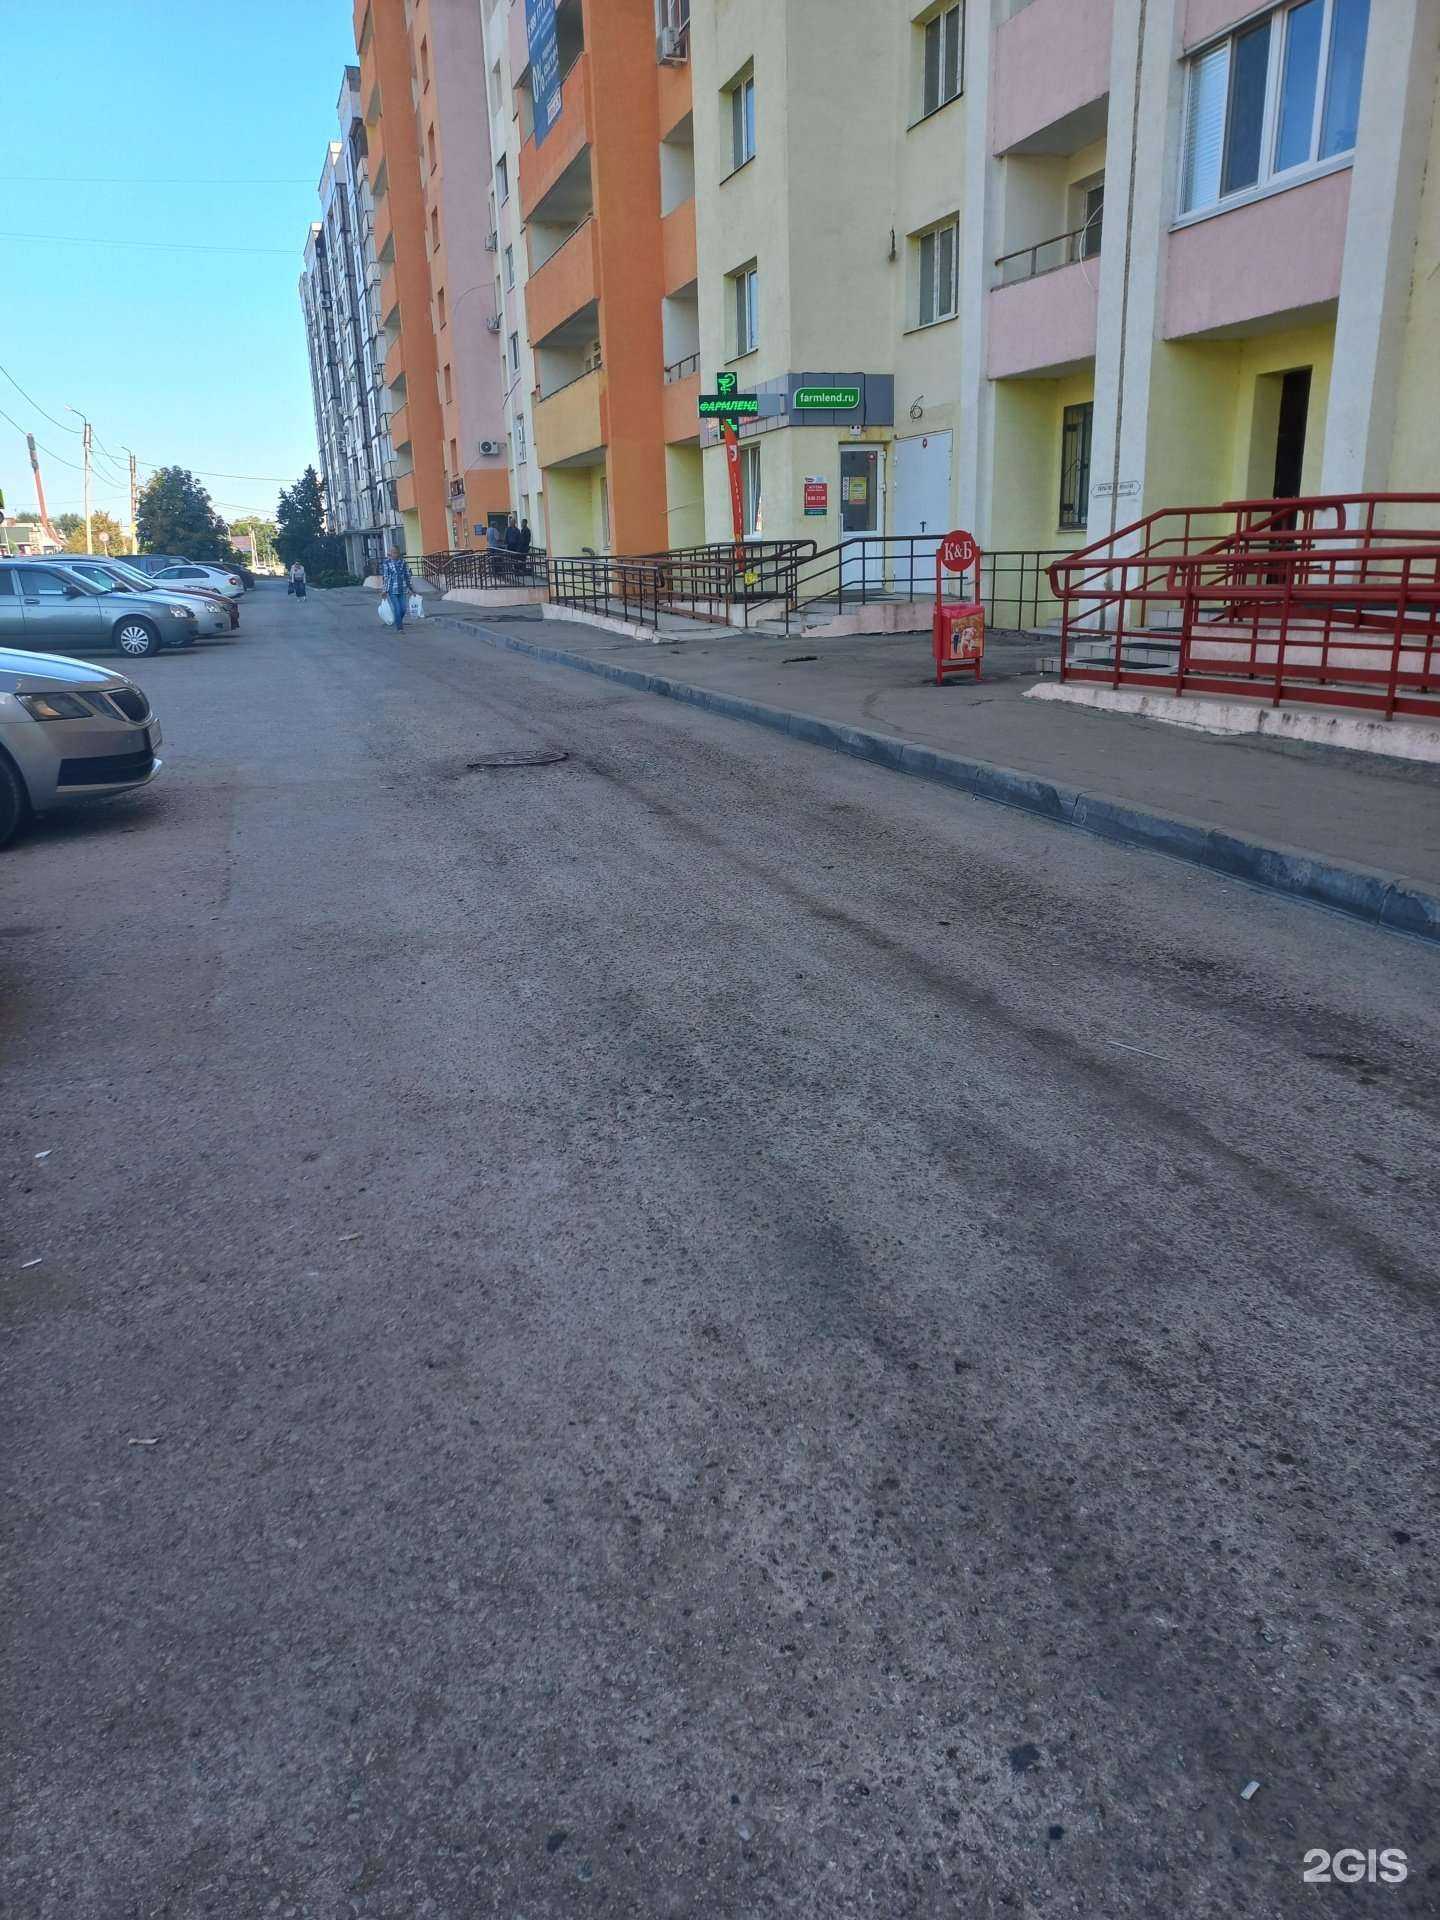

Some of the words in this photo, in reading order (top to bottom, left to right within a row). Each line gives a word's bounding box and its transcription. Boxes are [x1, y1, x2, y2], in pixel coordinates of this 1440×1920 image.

[800, 392, 855, 402] farmlend.ru
[700, 399, 758, 412] ФАРМЛЕНД
[944, 541, 973, 561] К&Б
